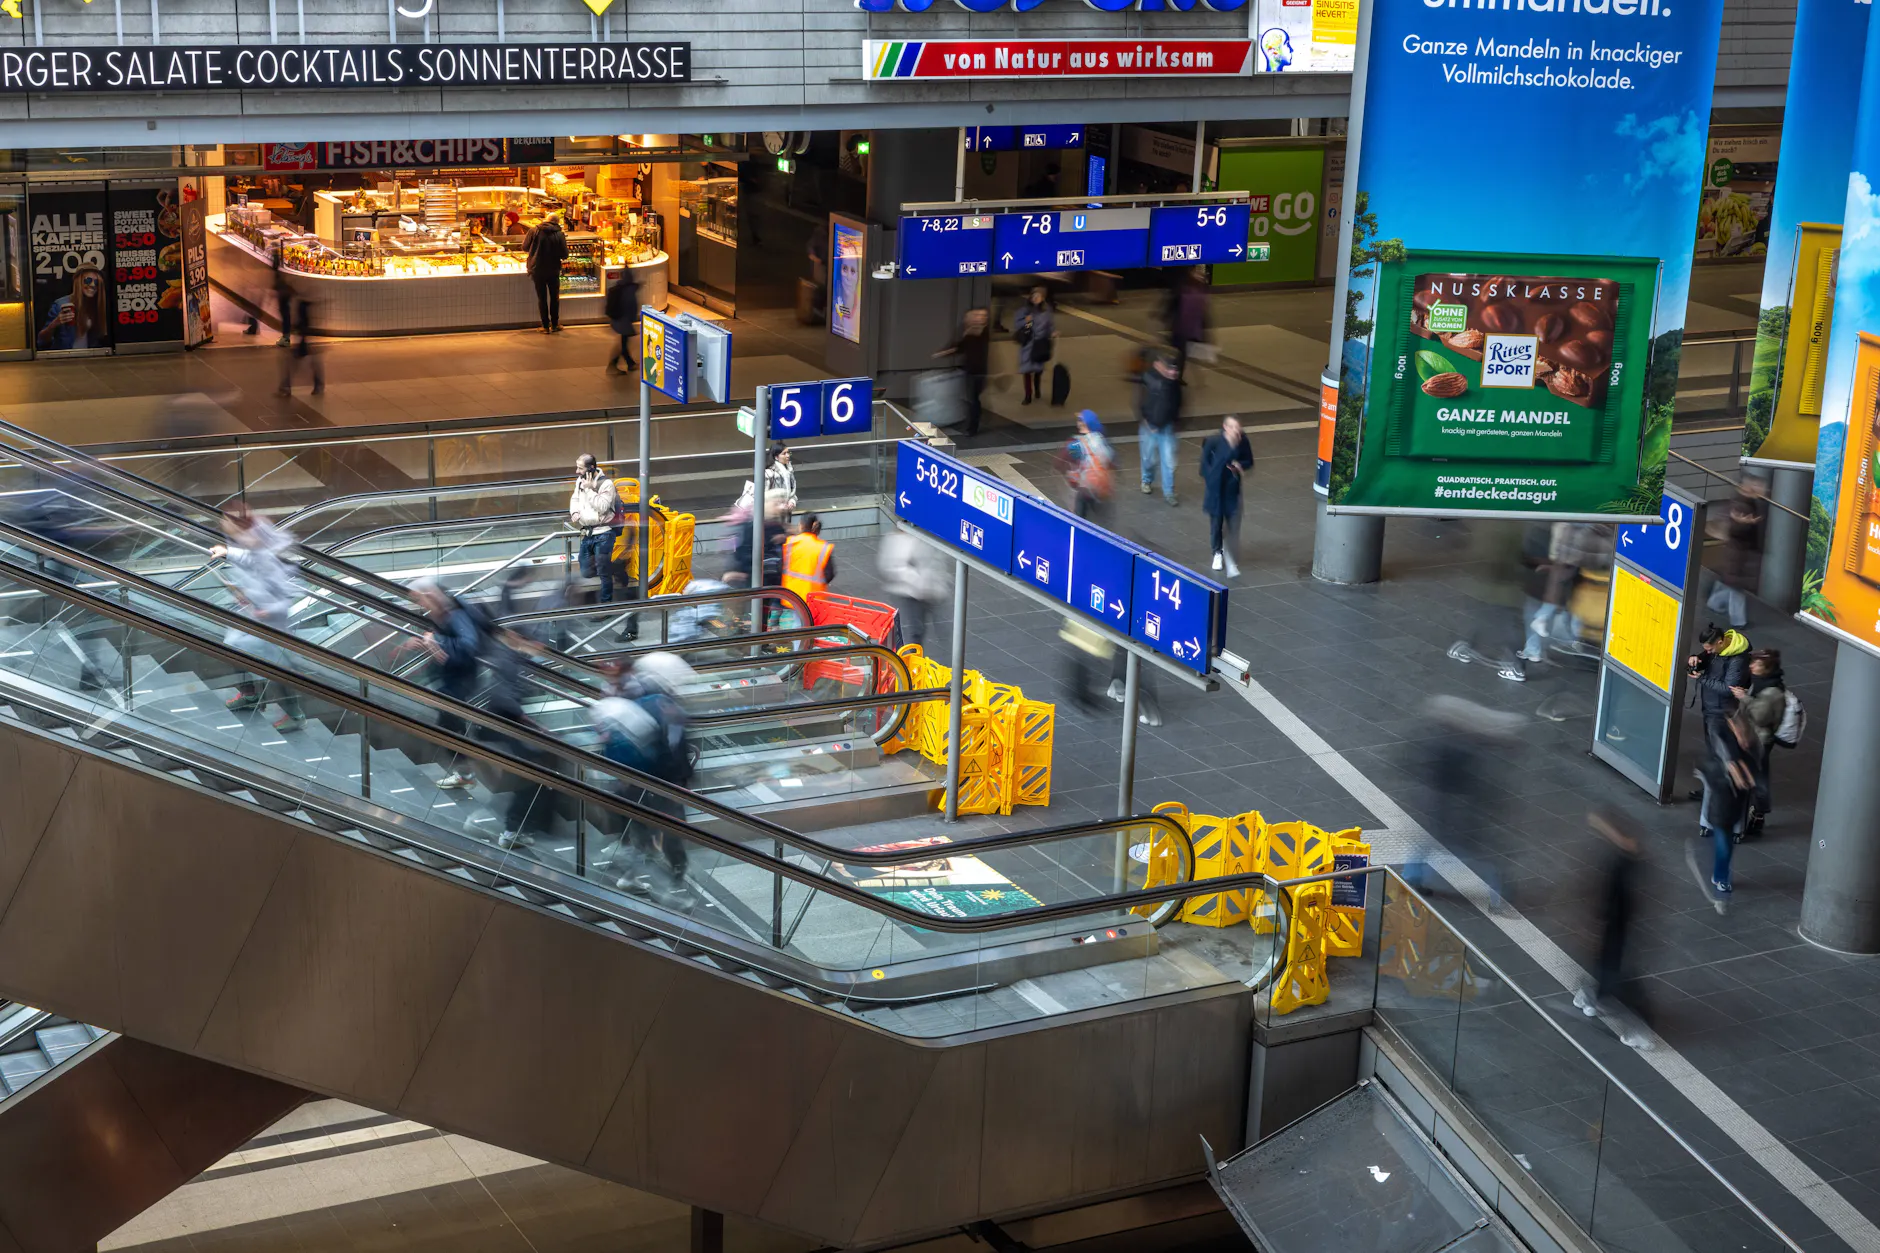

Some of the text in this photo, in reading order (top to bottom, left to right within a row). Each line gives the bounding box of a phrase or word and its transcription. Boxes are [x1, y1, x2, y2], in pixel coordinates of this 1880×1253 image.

[1316, 0, 1355, 10] SINUSITIS
[1316, 10, 1347, 18] HEVERT
[943, 44, 1214, 70] von Natur aus wirksam
[1402, 34, 1683, 69] Ganze Mandeln in knackiger
[106, 50, 223, 85] SALATE
[236, 49, 403, 84] COCKTAILS
[418, 47, 685, 82] SONNENTERRASSE
[1442, 62, 1636, 90] Vollmilchschokolade.
[1273, 191, 1315, 220] GO
[31, 212, 104, 233] ALLE
[114, 210, 154, 220] SWEET
[1074, 216, 1085, 229] U
[1196, 207, 1227, 227] 5-6
[114, 224, 156, 234] ECKEN
[1021, 214, 1052, 235] 7-8
[32, 231, 104, 245] KAFFEE
[116, 232, 156, 248] 5.50
[33, 243, 104, 253] SPEZIALITÄTEN
[116, 249, 156, 258] HEISSES
[188, 244, 205, 264] PILS
[36, 250, 105, 280] 2,00
[116, 266, 157, 282] 6.90
[117, 283, 158, 293] LACHS
[1431, 281, 1603, 300] NUSSKLASSE
[118, 298, 158, 312] BOX
[1433, 308, 1464, 317] OHNE
[118, 310, 158, 324] 6.90
[1489, 342, 1533, 363] Ritter
[1487, 364, 1531, 376] SPORT
[778, 388, 802, 427] 5
[830, 383, 854, 422] 6
[1436, 408, 1571, 425] GANZE MANDEL
[1442, 426, 1466, 436] knackig
[1476, 428, 1510, 437] gerösteten,
[1534, 430, 1562, 438] Mandeln
[916, 457, 958, 498] 5-8,22
[1437, 476, 1494, 484] QUADRATISCH.
[1494, 478, 1539, 486] PRAKTISCH.
[1434, 486, 1558, 504] #entdeckedasgut
[1000, 498, 1008, 518] U
[1664, 502, 1682, 550] 8
[1869, 522, 1880, 539] H
[1152, 570, 1182, 610] 1-4
[940, 899, 968, 918] Traum
